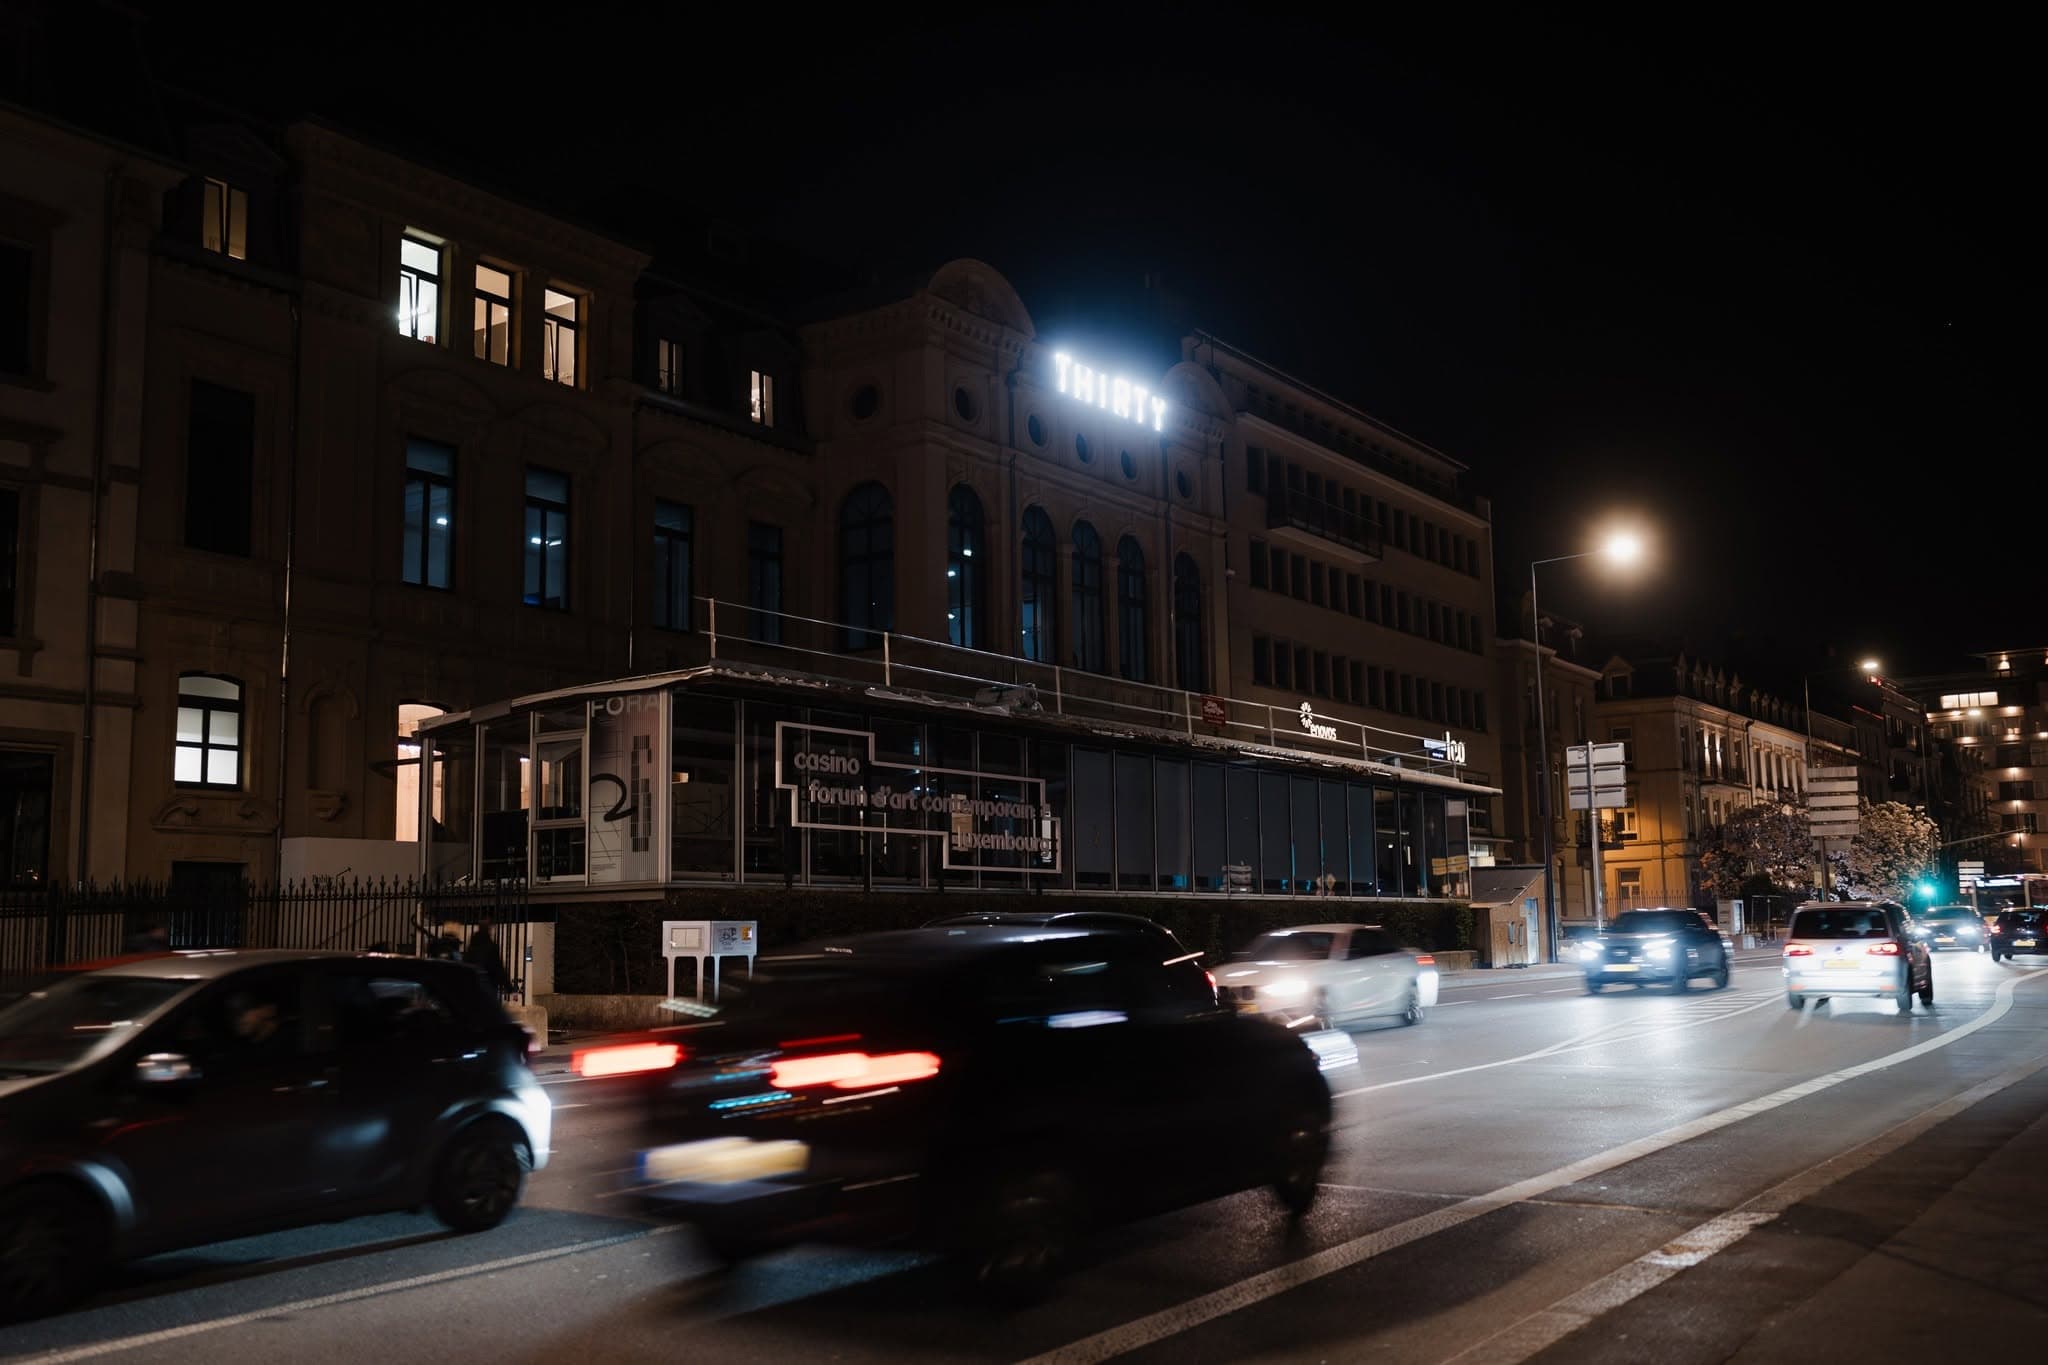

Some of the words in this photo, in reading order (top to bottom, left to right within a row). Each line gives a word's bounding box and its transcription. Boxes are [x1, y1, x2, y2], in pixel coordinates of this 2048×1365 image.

[1055, 352, 1166, 432] THIRTY
[793, 750, 861, 775] casino
[808, 779, 868, 807] forum
[921, 796, 1036, 823] contemporain
[956, 826, 1052, 858] luxembourg
